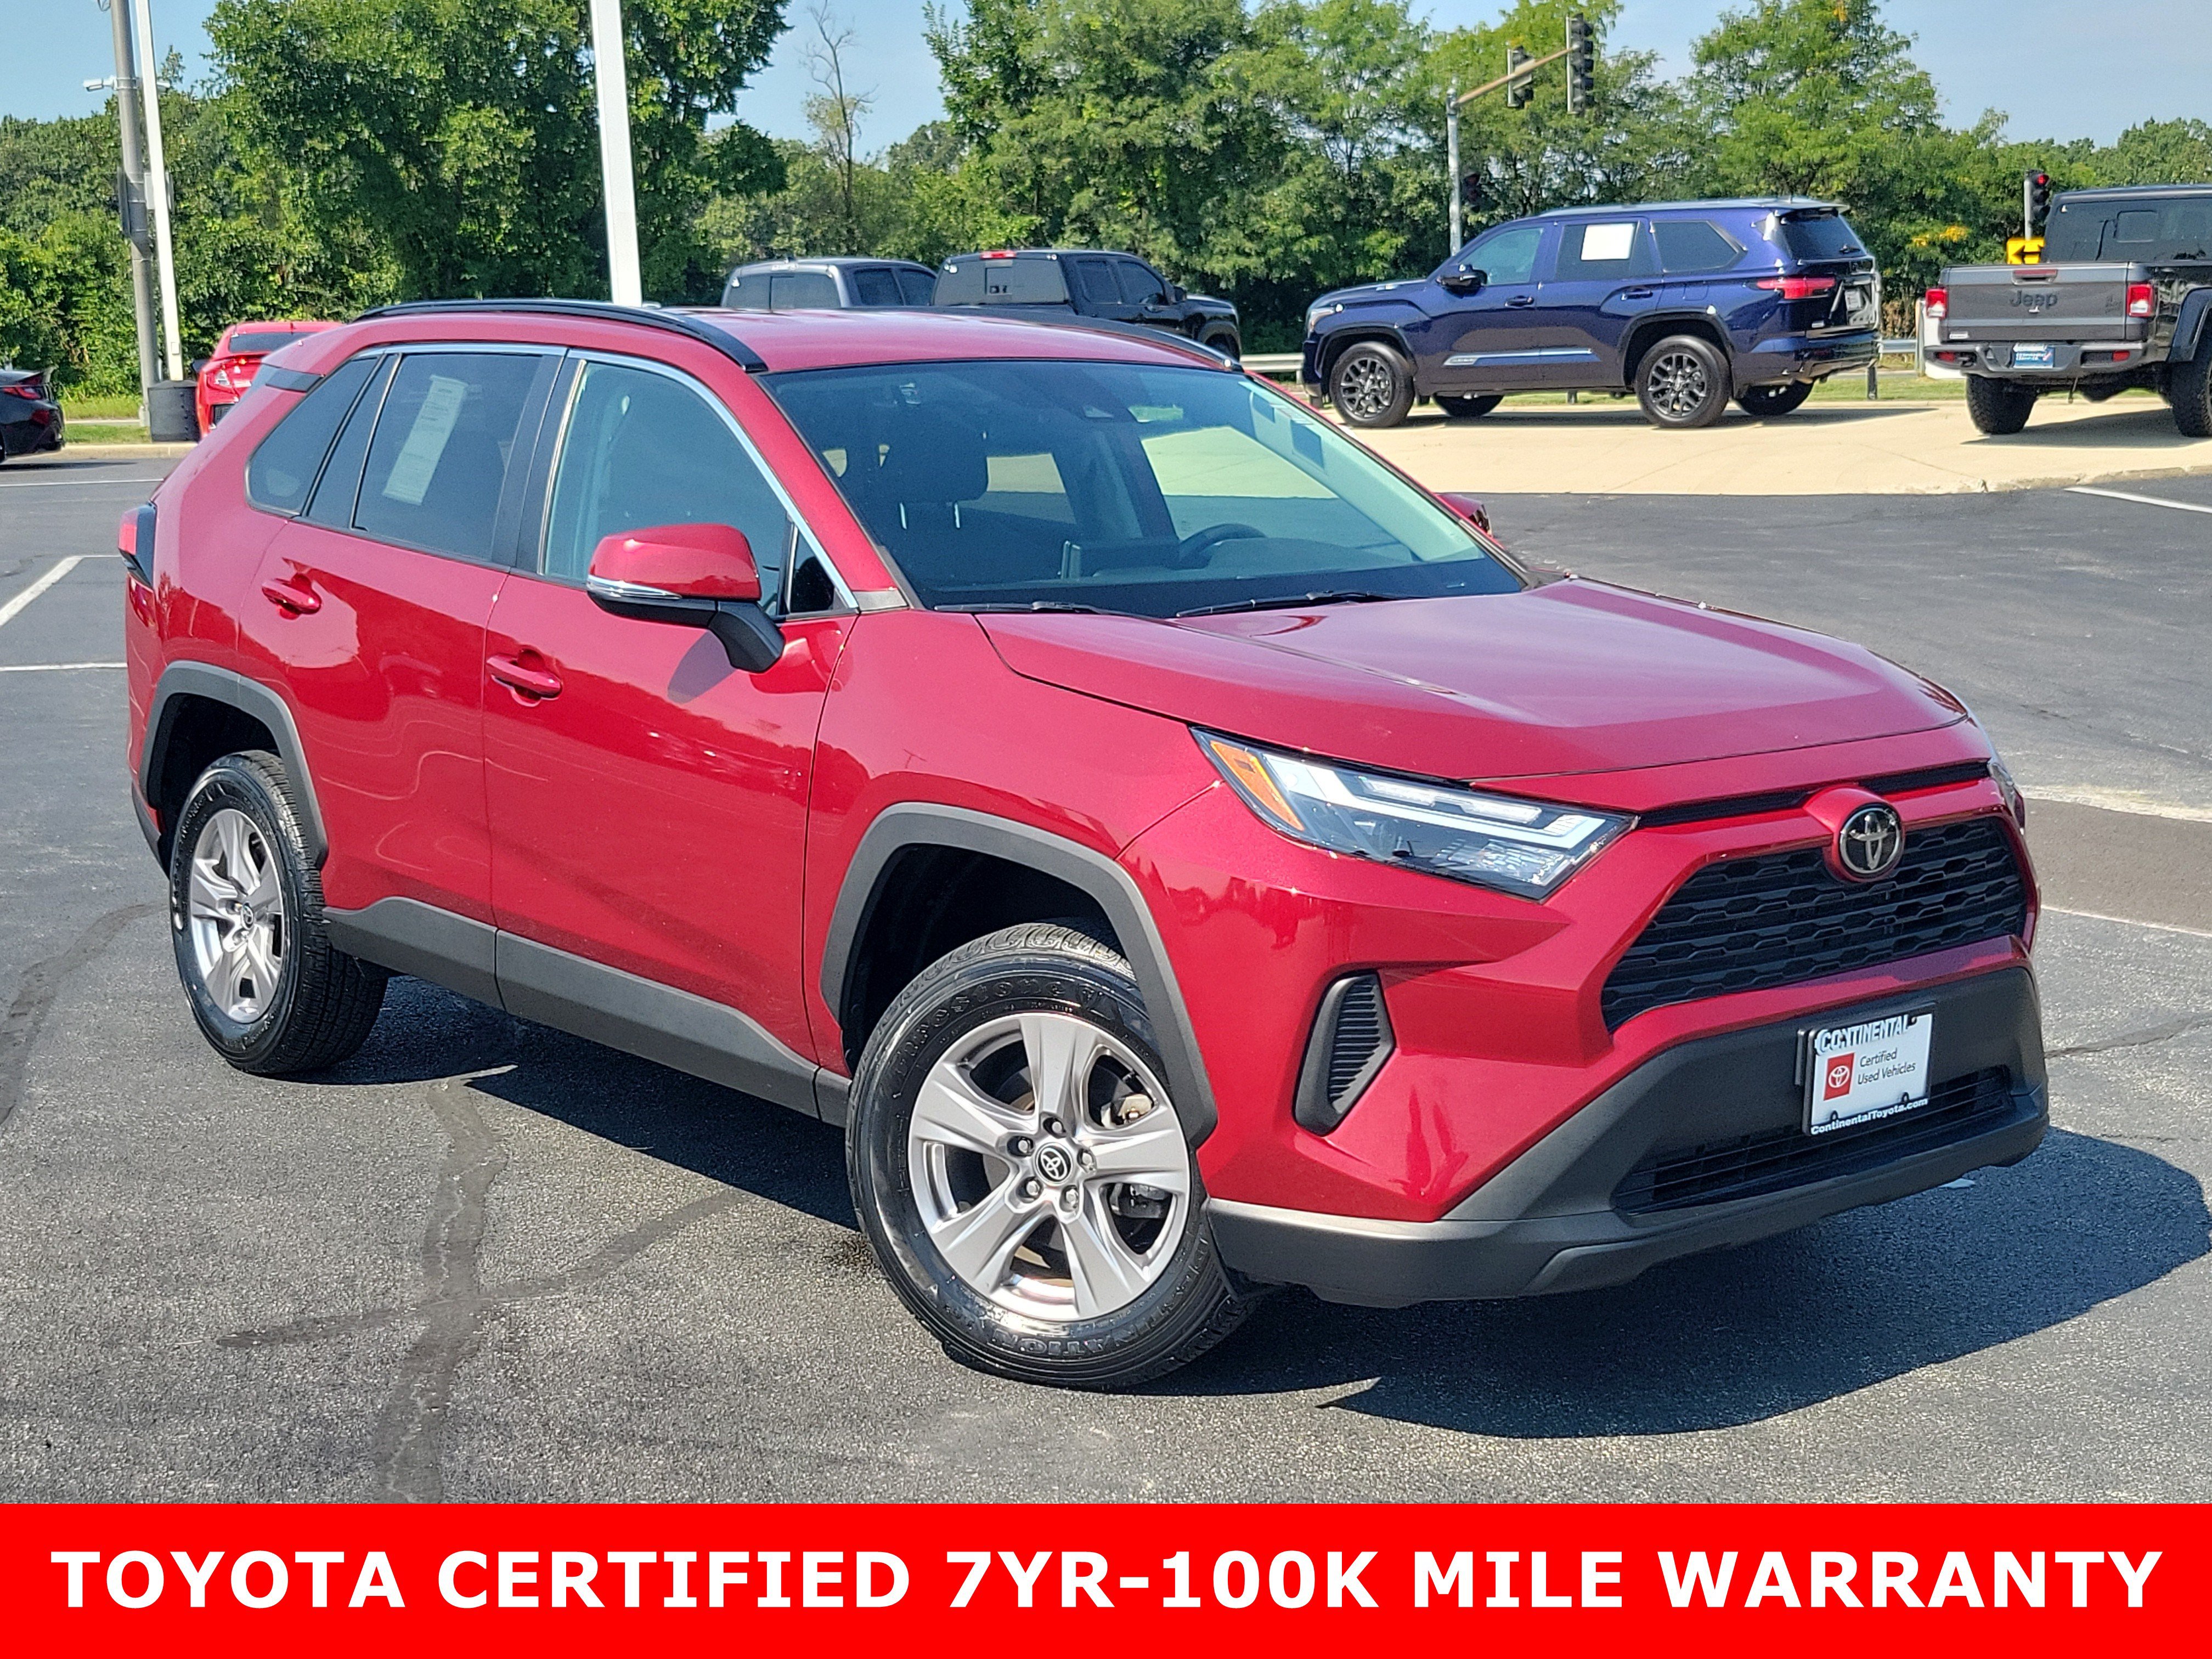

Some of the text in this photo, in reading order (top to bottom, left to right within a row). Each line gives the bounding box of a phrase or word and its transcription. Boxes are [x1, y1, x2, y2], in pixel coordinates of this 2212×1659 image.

[2010, 290, 2058, 310] Jeep
[1818, 1014, 1909, 1053] CONTINENTAL
[1859, 1048, 1898, 1068] Certified
[1857, 1062, 1916, 1085] Used Vehicles
[1810, 1098, 1928, 1136] ContinentalToyota.com
